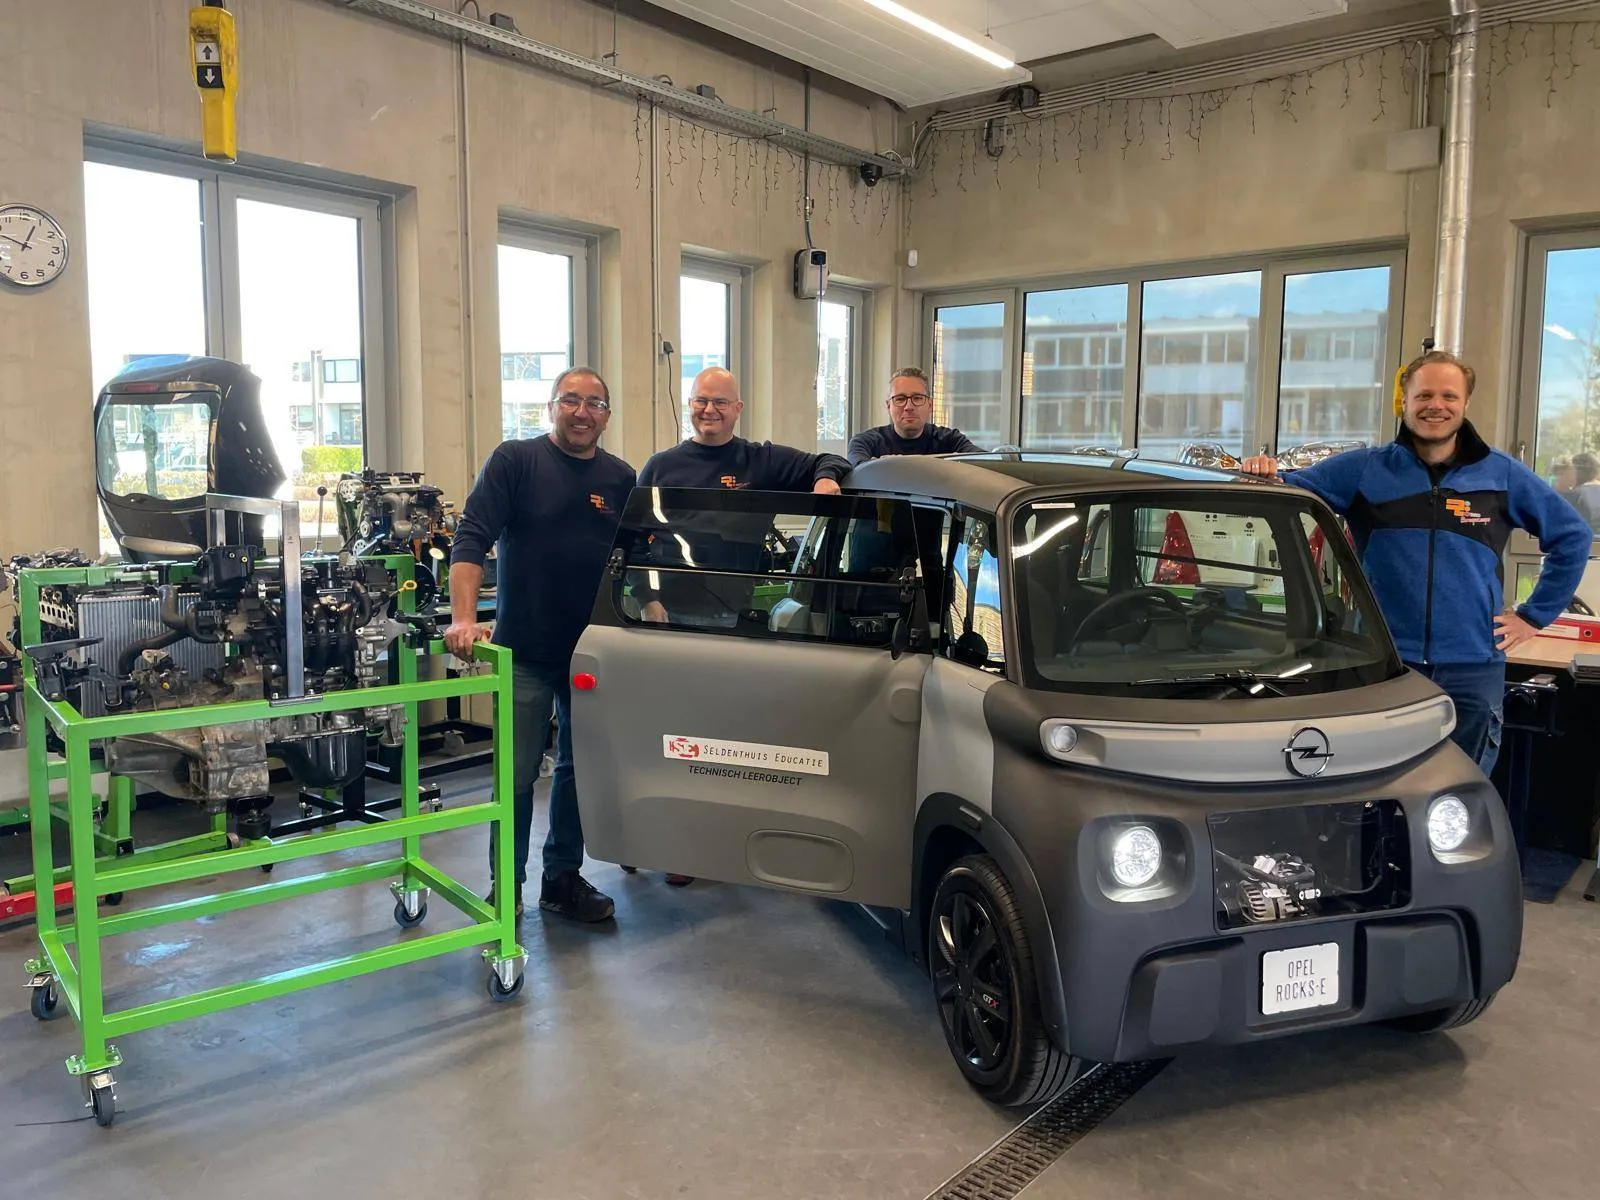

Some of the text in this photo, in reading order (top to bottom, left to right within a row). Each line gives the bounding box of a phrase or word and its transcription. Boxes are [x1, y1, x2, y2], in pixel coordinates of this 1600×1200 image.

[47, 231, 56, 239] 2
[51, 246, 61, 255] 3
[4, 265, 13, 274] 7
[36, 269, 45, 277] 5
[20, 271, 29, 280] 6
[703, 744, 823, 768] SELDENTHUIS EDUCATIE
[688, 765, 803, 786] TECHNISCH LEEROBJECT
[1288, 958, 1316, 978] OPEL
